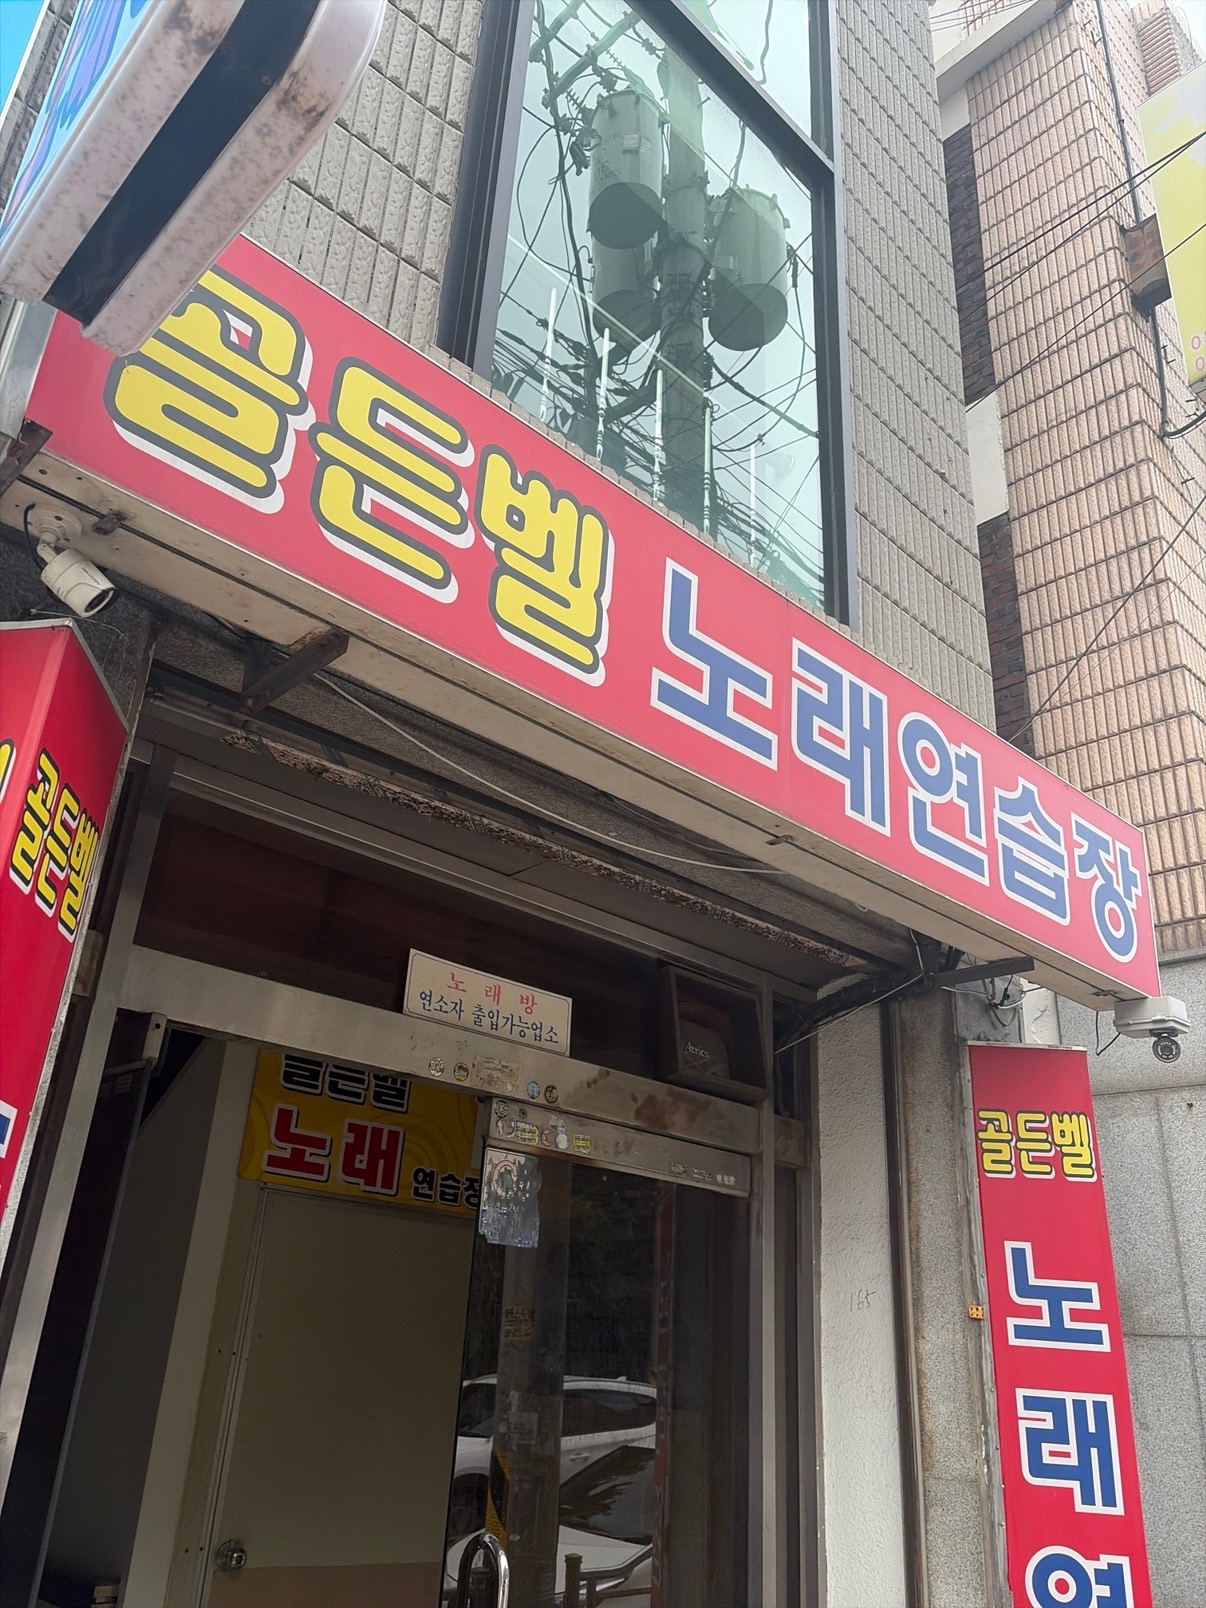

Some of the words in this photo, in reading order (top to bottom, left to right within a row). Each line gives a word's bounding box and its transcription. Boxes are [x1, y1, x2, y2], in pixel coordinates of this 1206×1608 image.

[104, 269, 615, 687] 골든벨
[650, 557, 1142, 963] 노래연습장
[9, 747, 99, 943] 골든벨
[419, 989, 464, 1021] 연소자
[471, 1003, 559, 1044] 출입가능업소
[262, 1103, 405, 1195] 노래
[976, 1108, 1098, 1182] 골든벨
